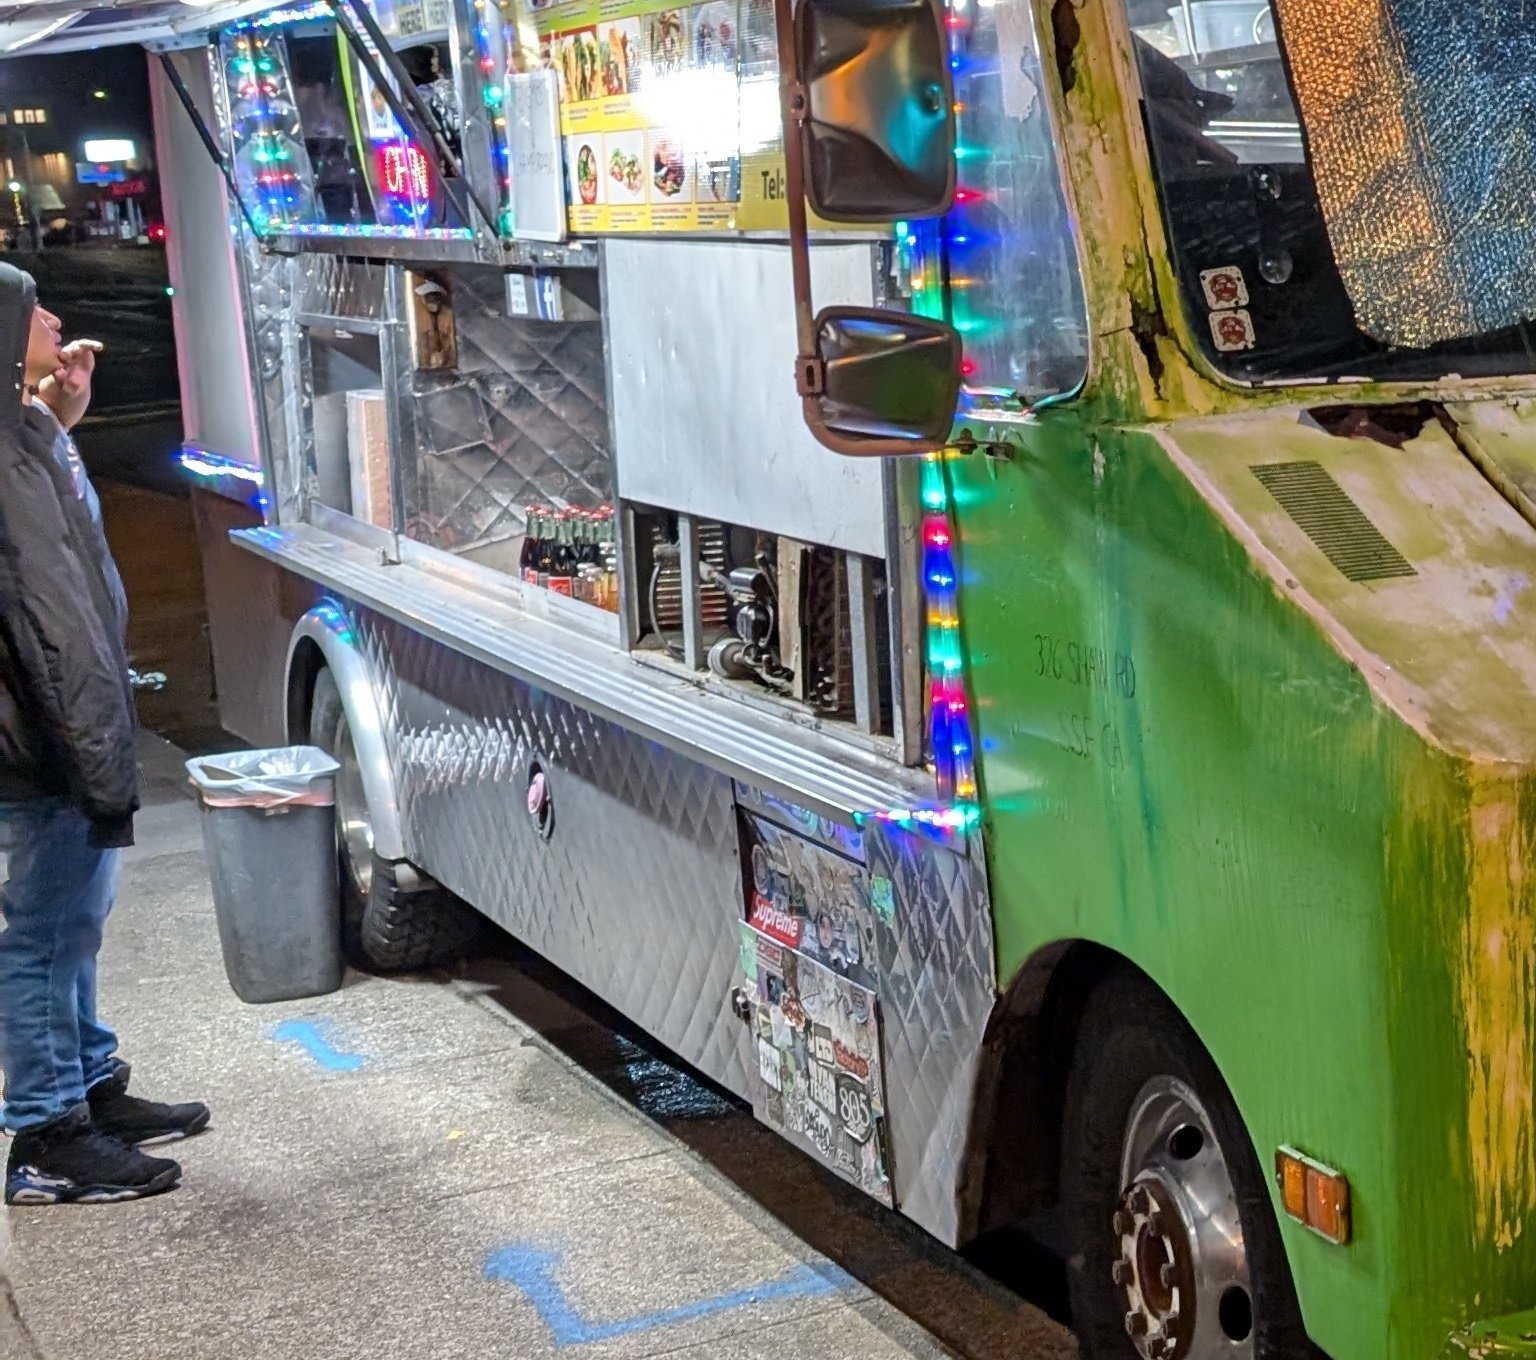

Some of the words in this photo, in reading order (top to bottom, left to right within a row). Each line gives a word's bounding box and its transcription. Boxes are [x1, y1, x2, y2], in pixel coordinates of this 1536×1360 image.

[761, 167, 785, 200] Tel:
[1114, 651, 1136, 700] RD
[1102, 722, 1125, 770] CA
[752, 892, 799, 938] Supreme
[838, 1086, 871, 1128] 805
